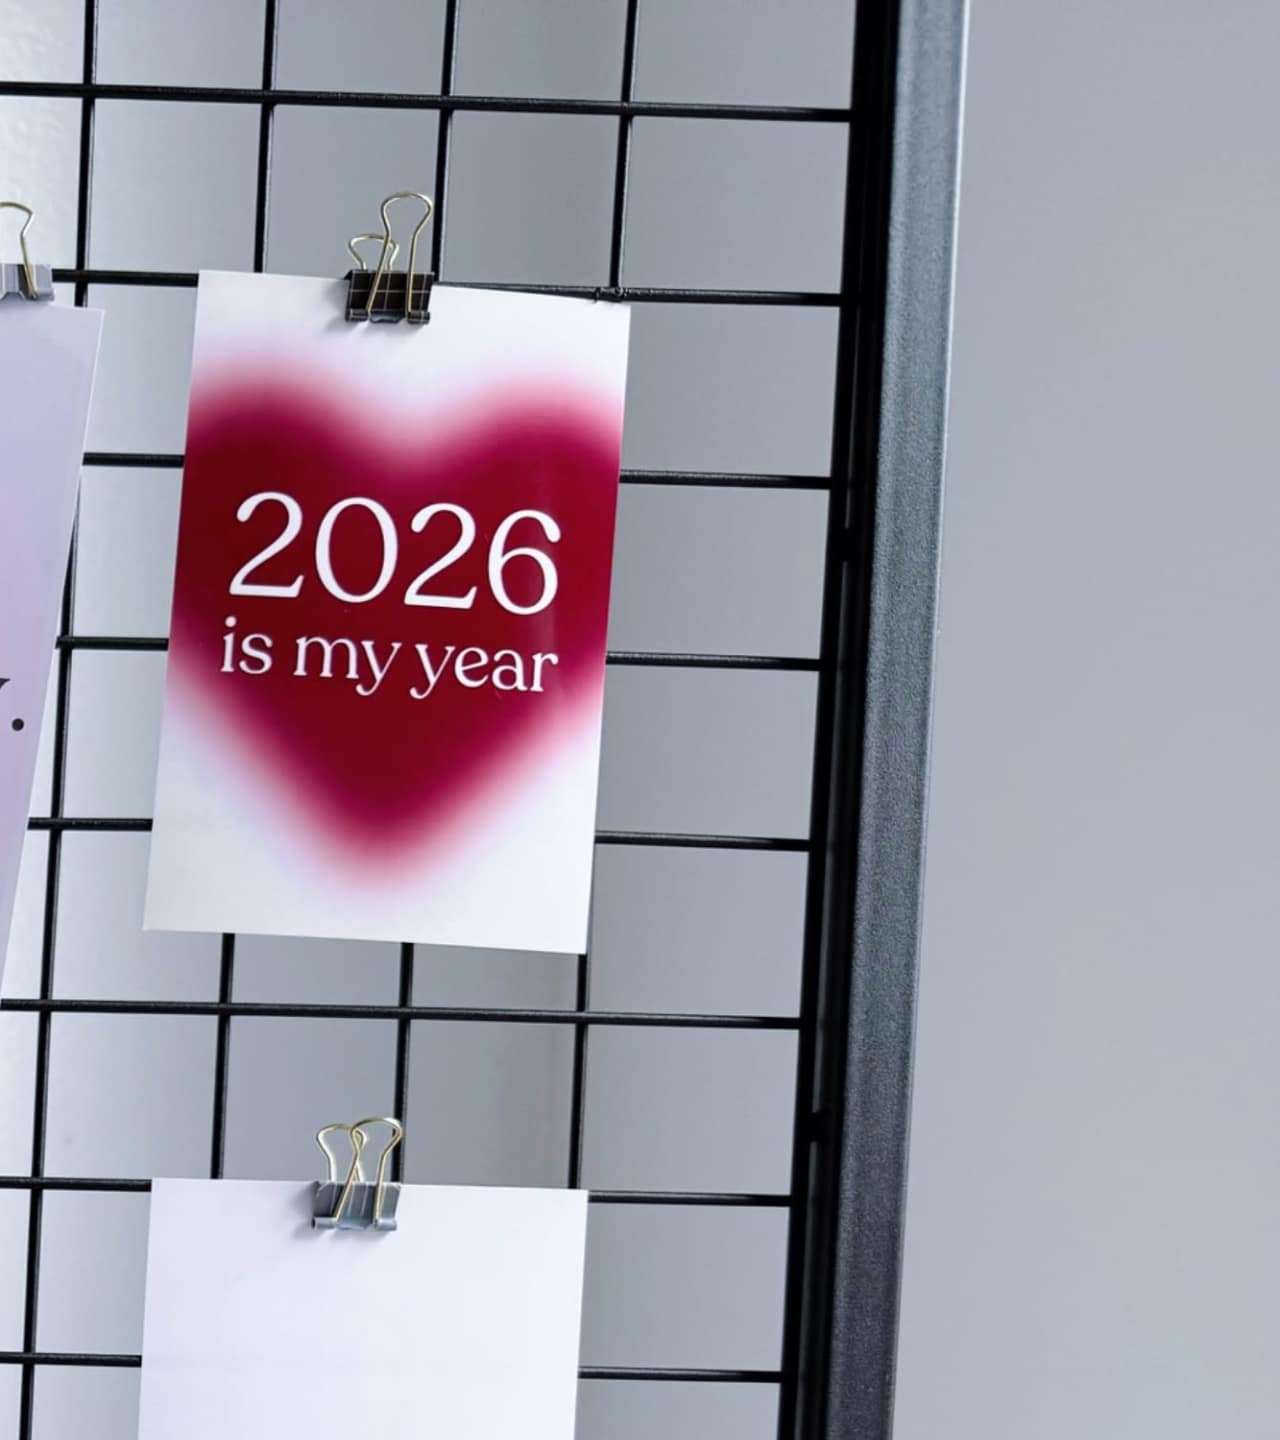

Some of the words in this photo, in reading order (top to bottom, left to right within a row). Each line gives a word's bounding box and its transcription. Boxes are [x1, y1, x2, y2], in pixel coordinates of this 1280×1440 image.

[225, 492, 561, 615] 2026
[220, 616, 273, 675] is
[292, 635, 403, 697] my
[409, 643, 560, 699] year
